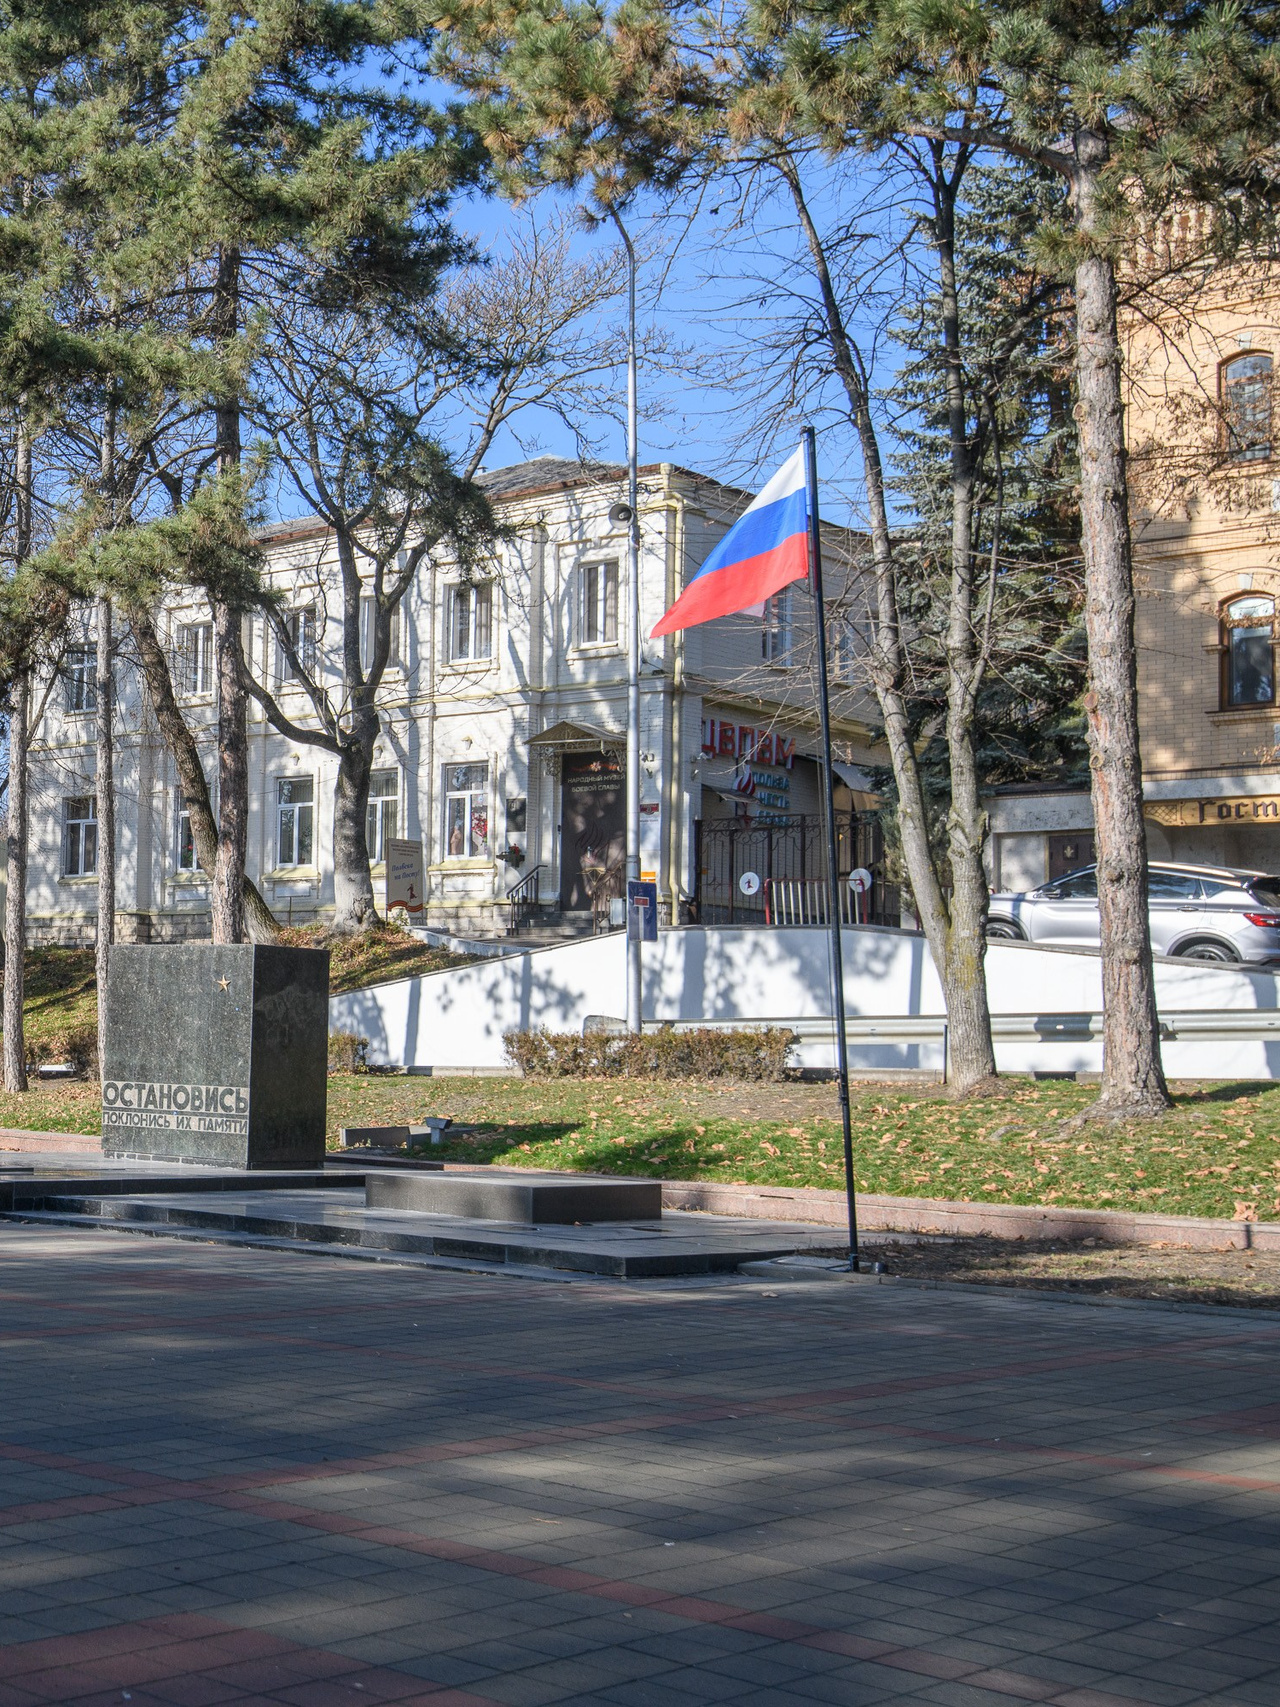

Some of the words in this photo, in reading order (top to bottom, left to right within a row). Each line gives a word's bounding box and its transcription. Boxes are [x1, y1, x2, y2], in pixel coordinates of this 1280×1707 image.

[567, 774, 603, 784] НАРОДНЫЙ
[604, 773, 626, 782] МУЗЕЙ
[571, 784, 597, 793] БОЕВОЙ
[597, 783, 621, 792] СЛАВЫ
[103, 1081, 249, 1114] ОСТАНОВИСЬ
[102, 1110, 171, 1129] ПОКЛОНИСЬ
[176, 1116, 192, 1130] ИХ
[197, 1117, 249, 1134] ПАМЯТИ
